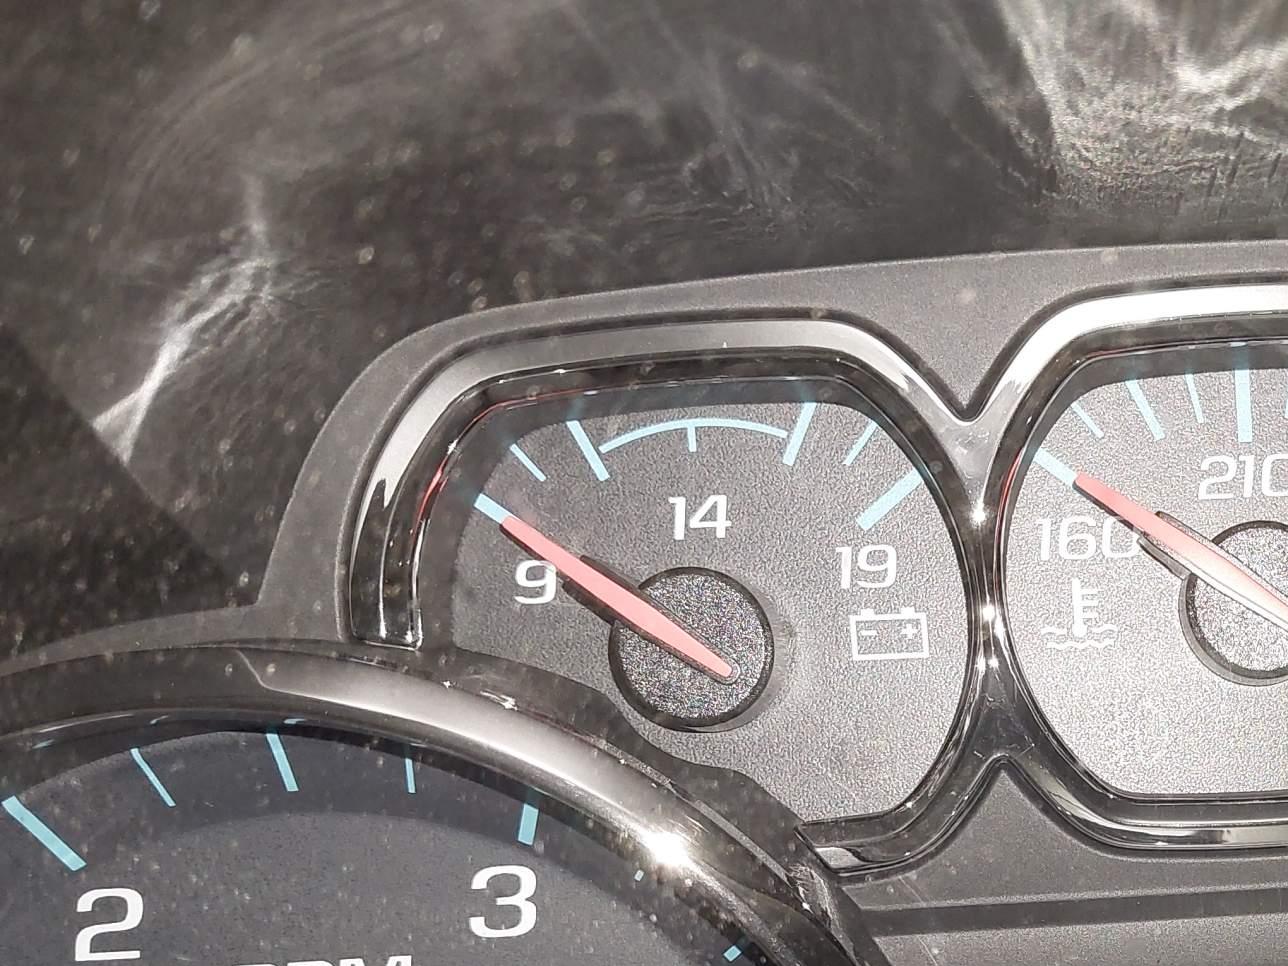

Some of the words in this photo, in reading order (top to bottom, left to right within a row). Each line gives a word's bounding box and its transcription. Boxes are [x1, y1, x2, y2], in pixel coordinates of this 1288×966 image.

[668, 494, 732, 541] 14
[1037, 514, 1141, 562] 160
[514, 561, 557, 605] 9
[836, 544, 898, 590] 19
[75, 888, 143, 961] 2
[469, 865, 537, 938] 3
